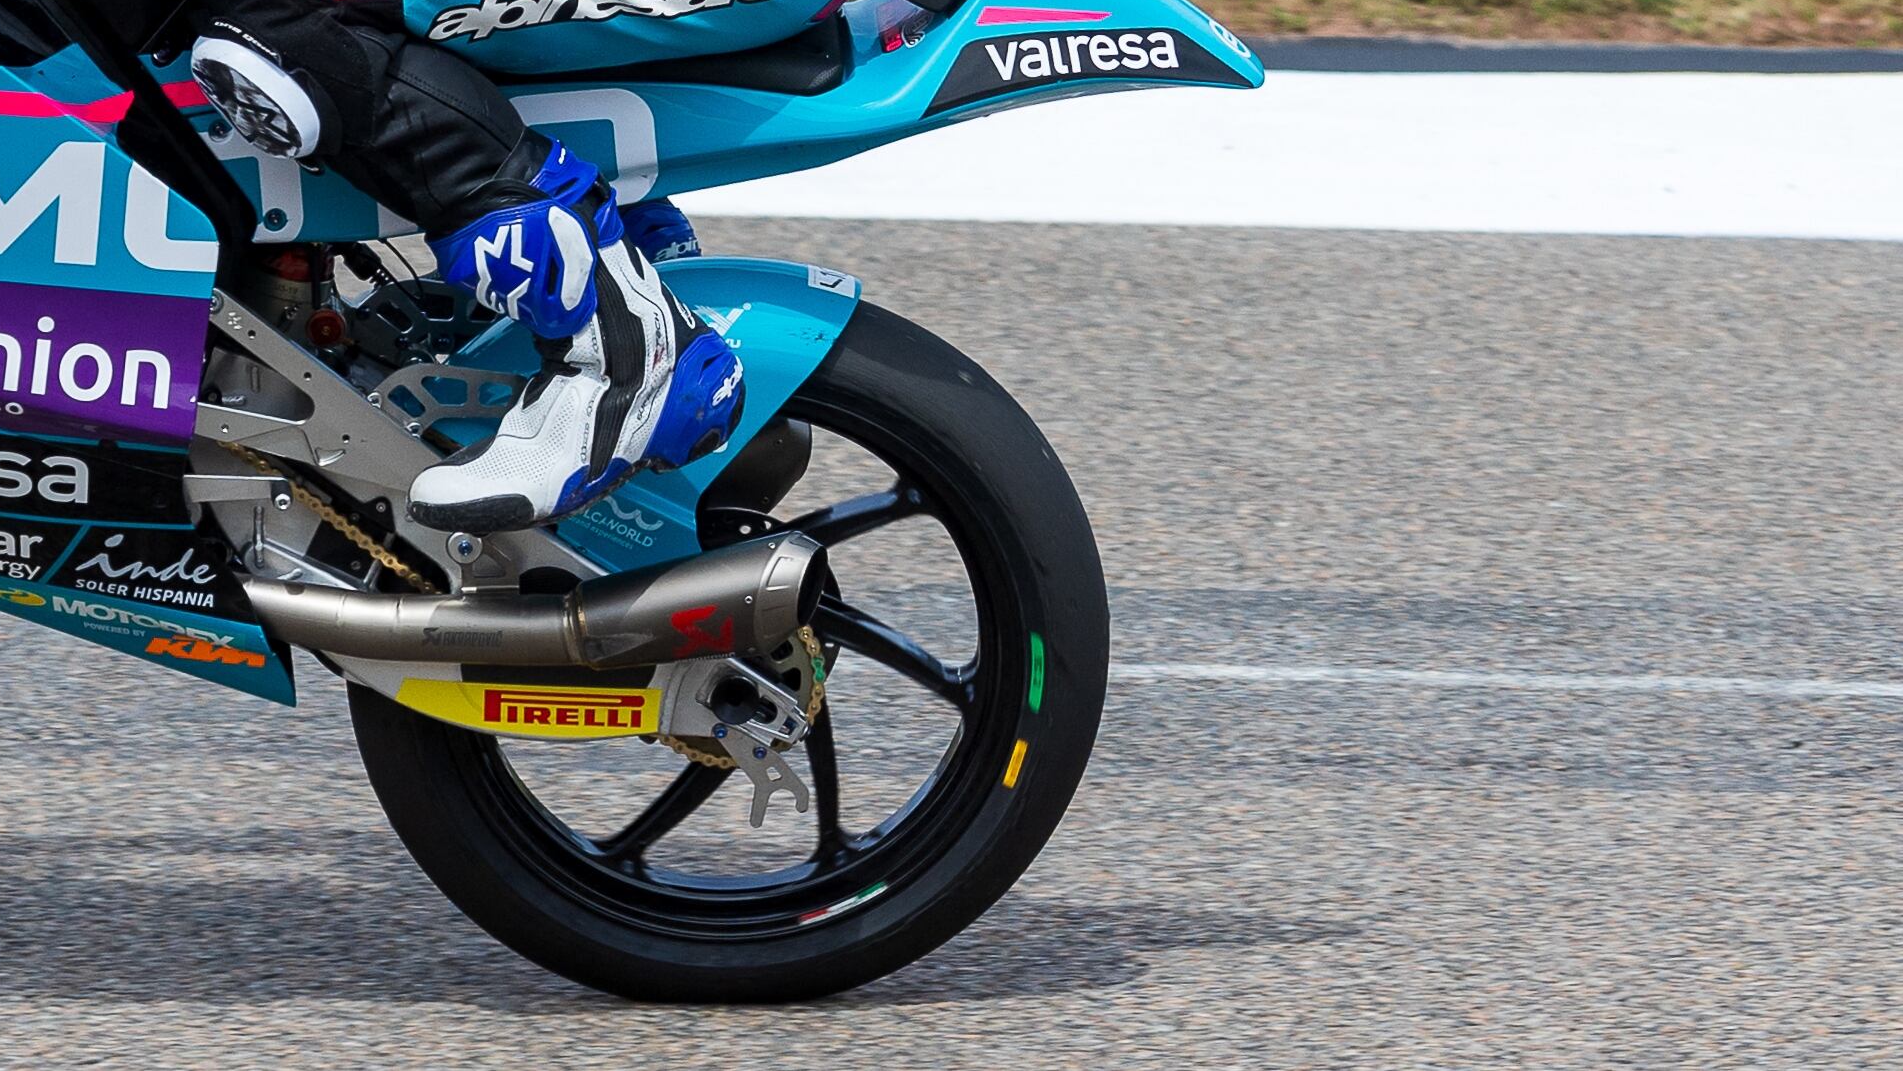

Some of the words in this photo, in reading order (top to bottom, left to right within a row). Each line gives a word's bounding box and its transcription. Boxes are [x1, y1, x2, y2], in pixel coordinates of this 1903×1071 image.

[985, 31, 1179, 81] valresa
[75, 578, 127, 597] SOLER
[133, 586, 214, 608] HISPANIA
[145, 634, 266, 668] KTM
[484, 689, 645, 728] PIRELLI
